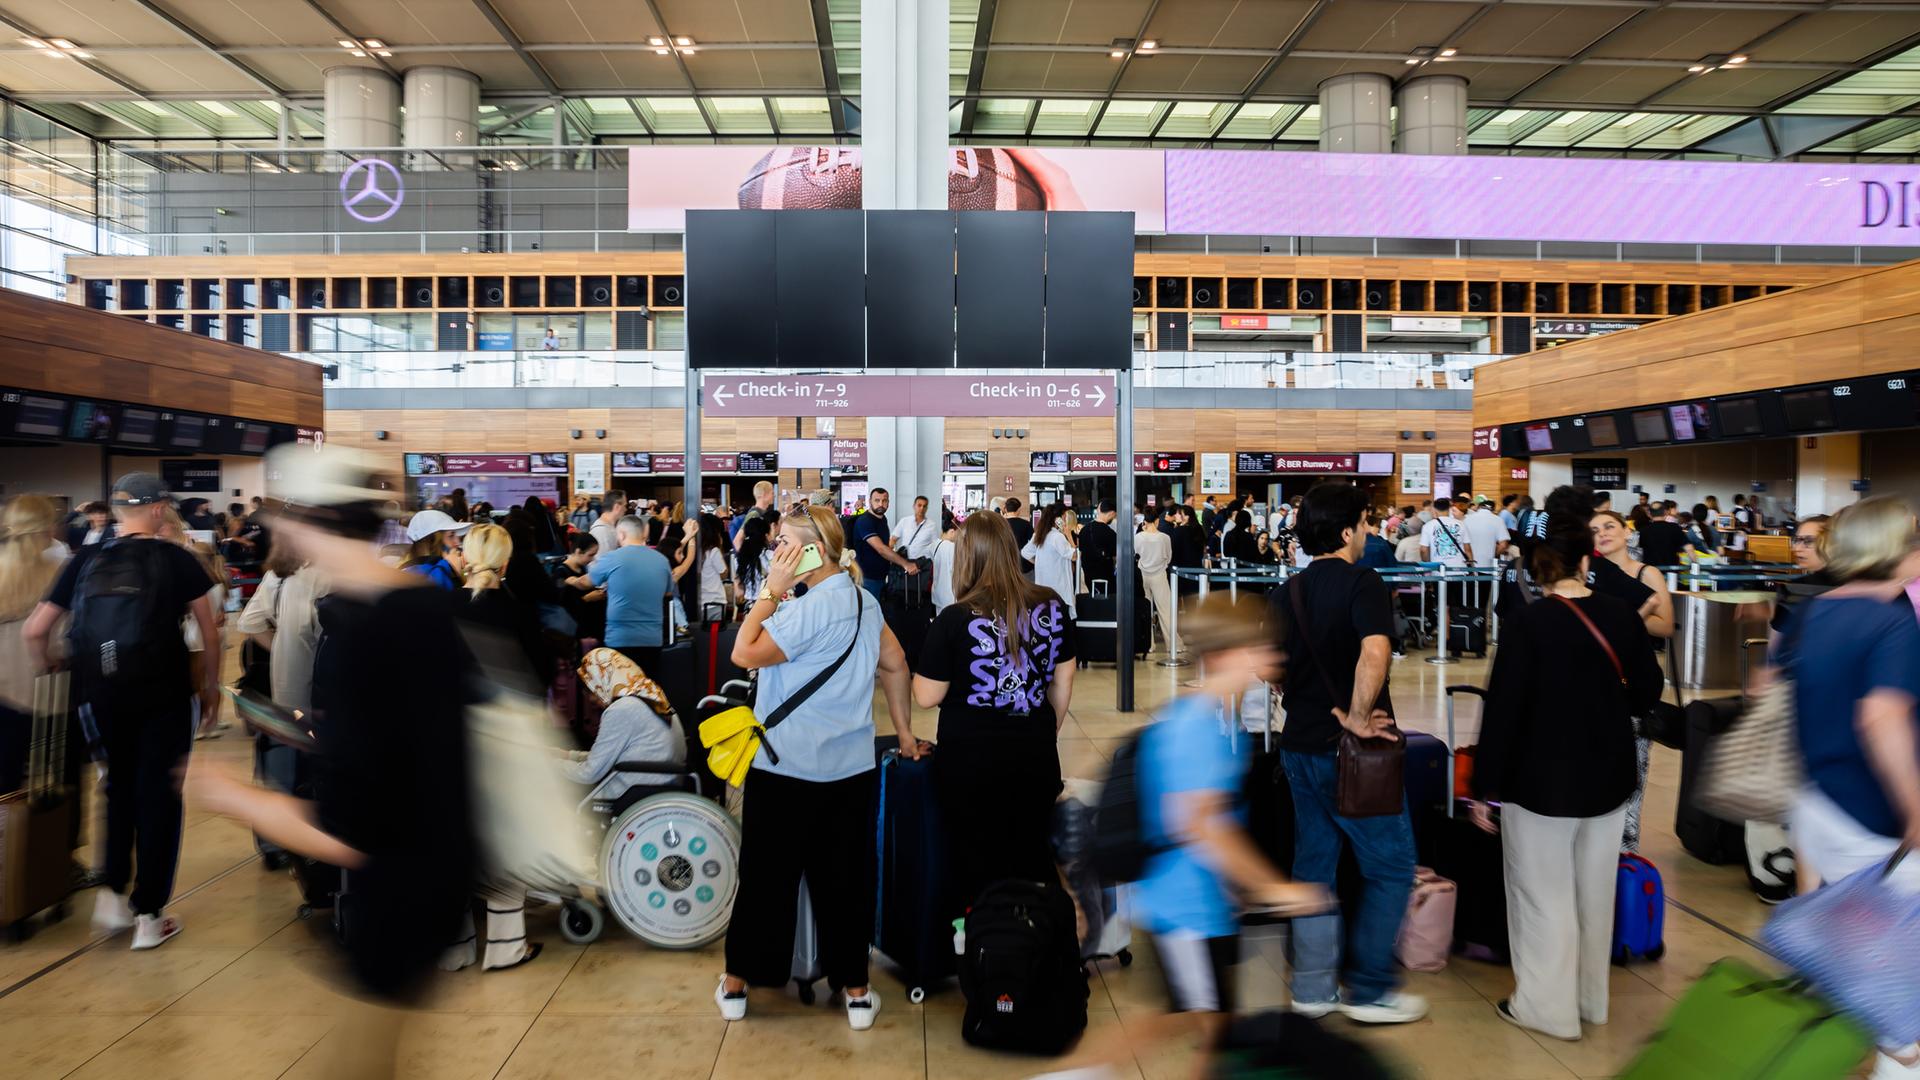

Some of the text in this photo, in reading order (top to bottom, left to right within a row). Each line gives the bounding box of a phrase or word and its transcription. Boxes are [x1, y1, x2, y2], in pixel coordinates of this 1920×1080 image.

[738, 381, 811, 397] Check-in
[970, 382, 1041, 397] Check-in
[833, 440, 859, 449] Abflug
[1489, 428, 1500, 452] 6
[1303, 461, 1334, 470] Runway
